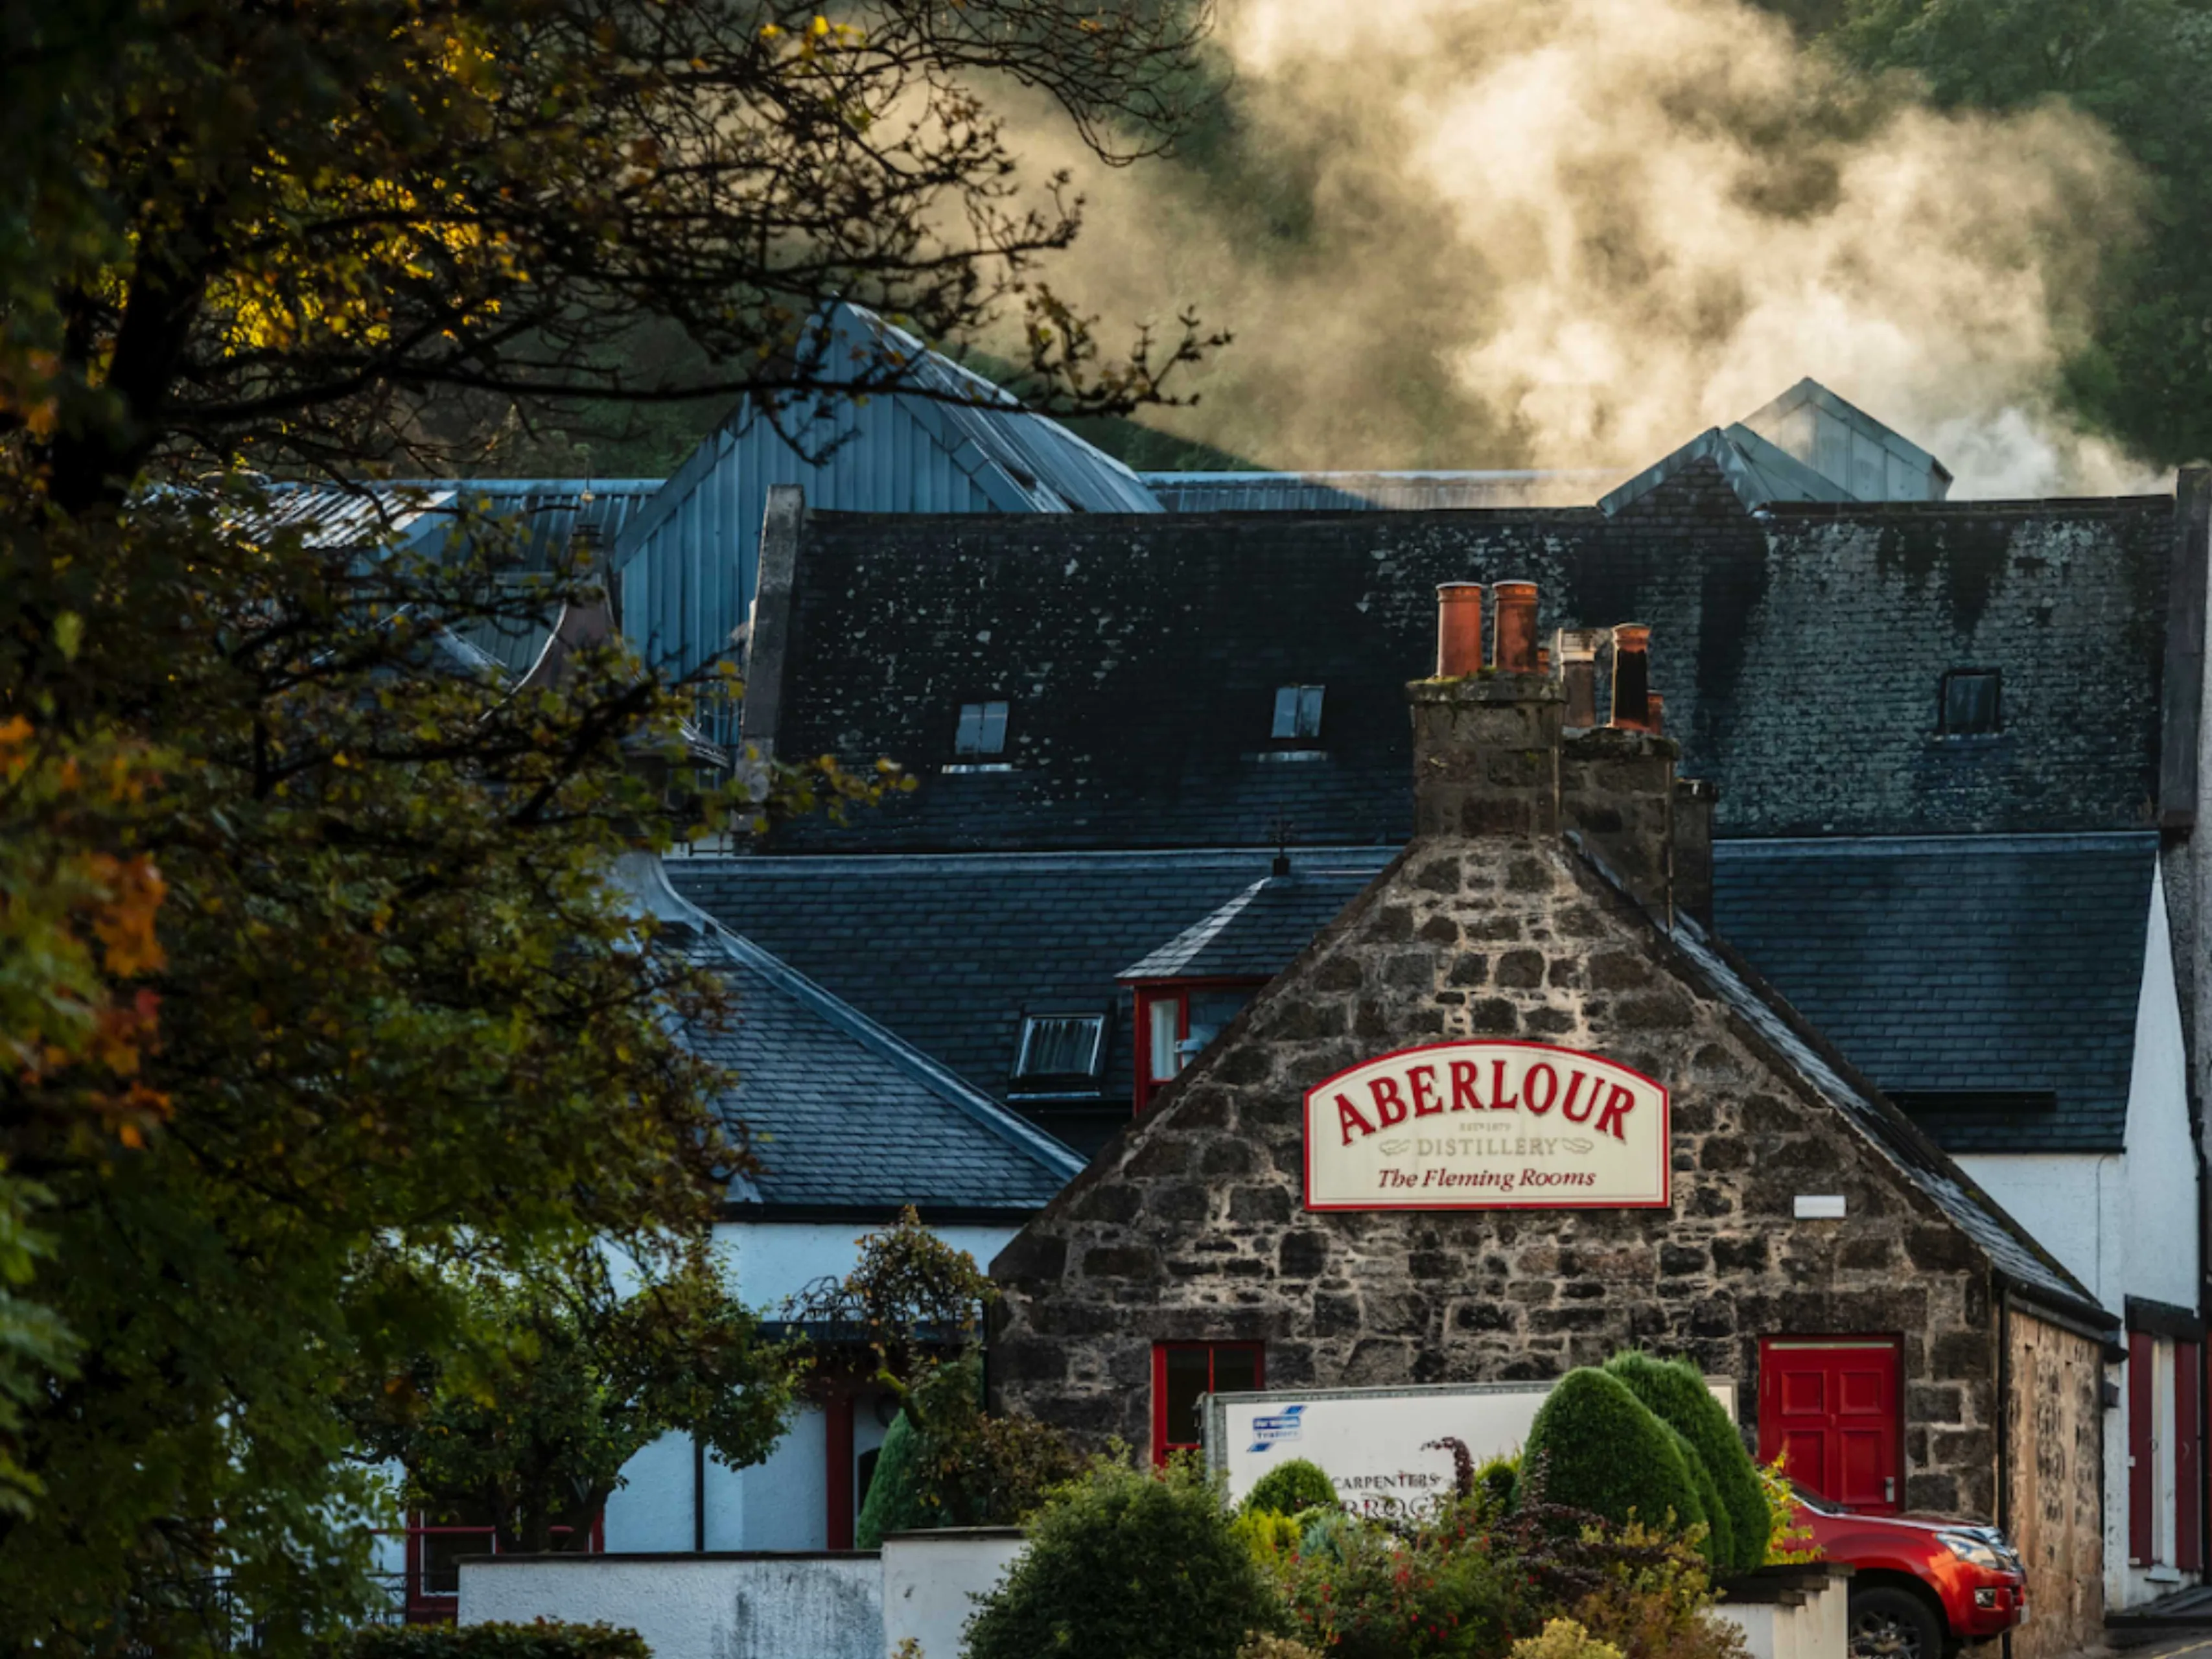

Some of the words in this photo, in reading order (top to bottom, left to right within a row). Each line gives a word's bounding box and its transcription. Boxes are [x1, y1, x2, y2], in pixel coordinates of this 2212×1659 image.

[1334, 1059, 1635, 1146] ABERLOUR
[1417, 1138, 1557, 1157] DISTILLERY
[1379, 1168, 1417, 1188] The
[1422, 1168, 1515, 1192] Fleming
[1519, 1168, 1596, 1187] Rooms
